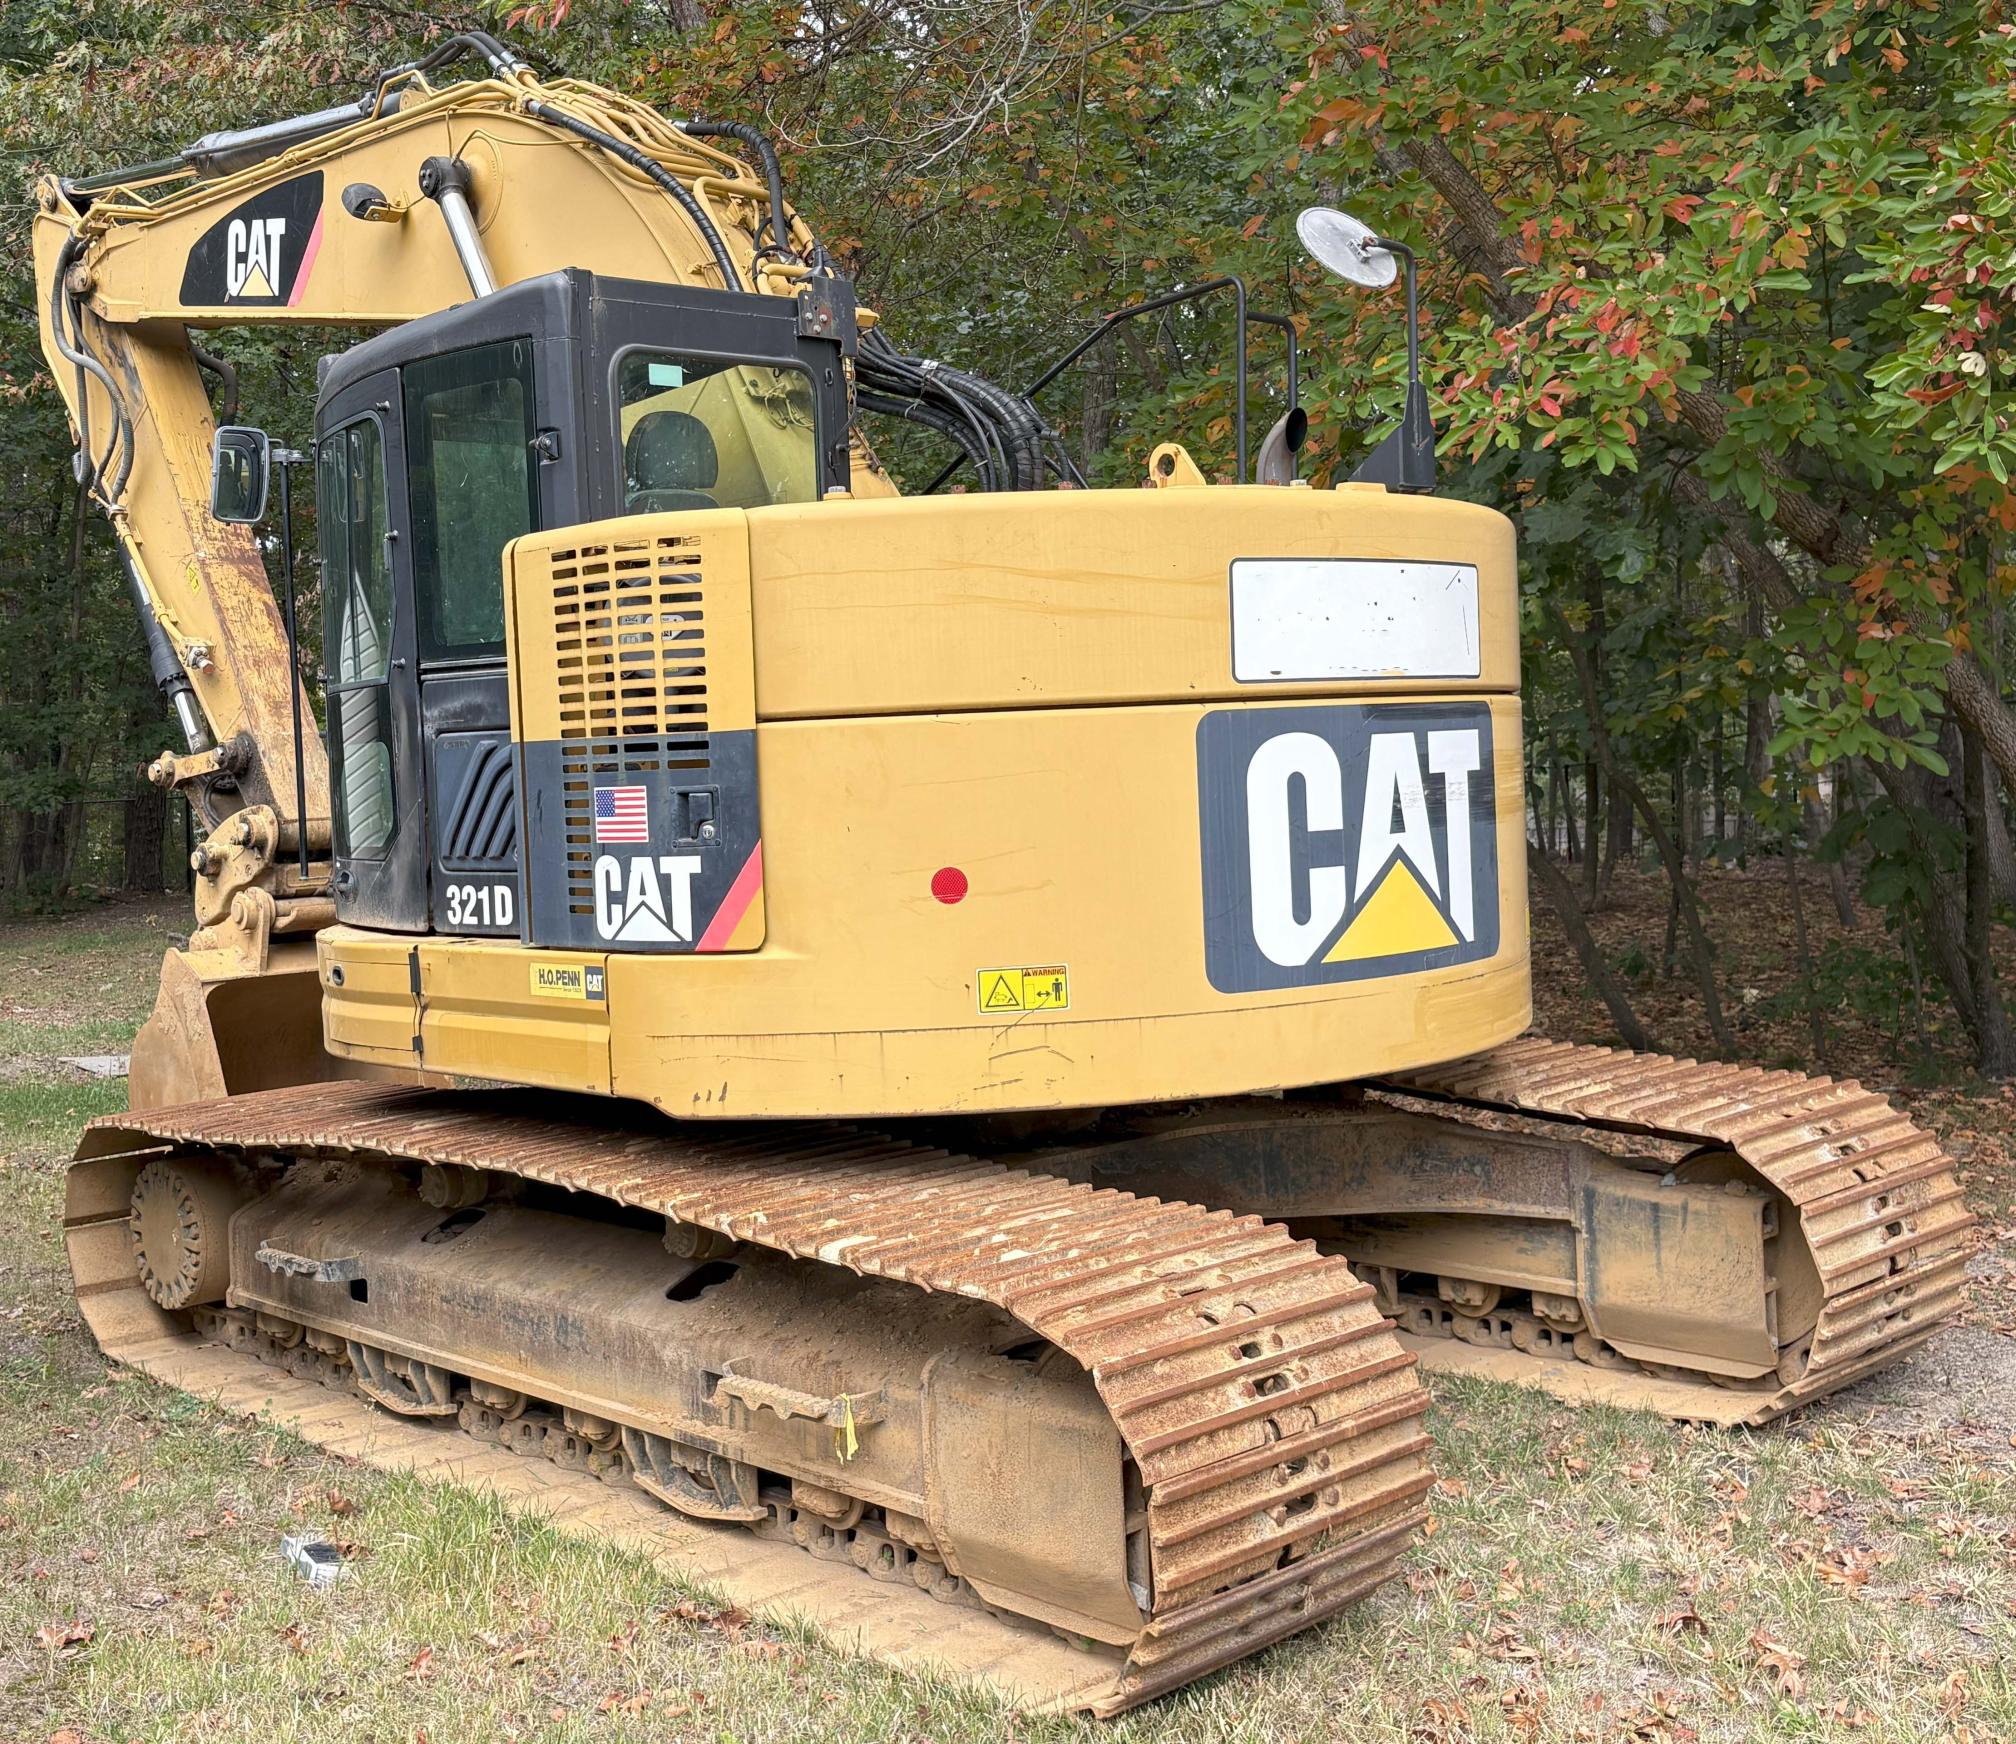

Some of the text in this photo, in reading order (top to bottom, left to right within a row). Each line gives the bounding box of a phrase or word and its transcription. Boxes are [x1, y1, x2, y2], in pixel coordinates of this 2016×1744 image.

[226, 217, 286, 297] CAT
[1246, 728, 1481, 967] CAT
[445, 884, 514, 926] 321D
[594, 854, 702, 942] CAT
[586, 973, 604, 992] CAT
[1031, 967, 1065, 977] WARNING
